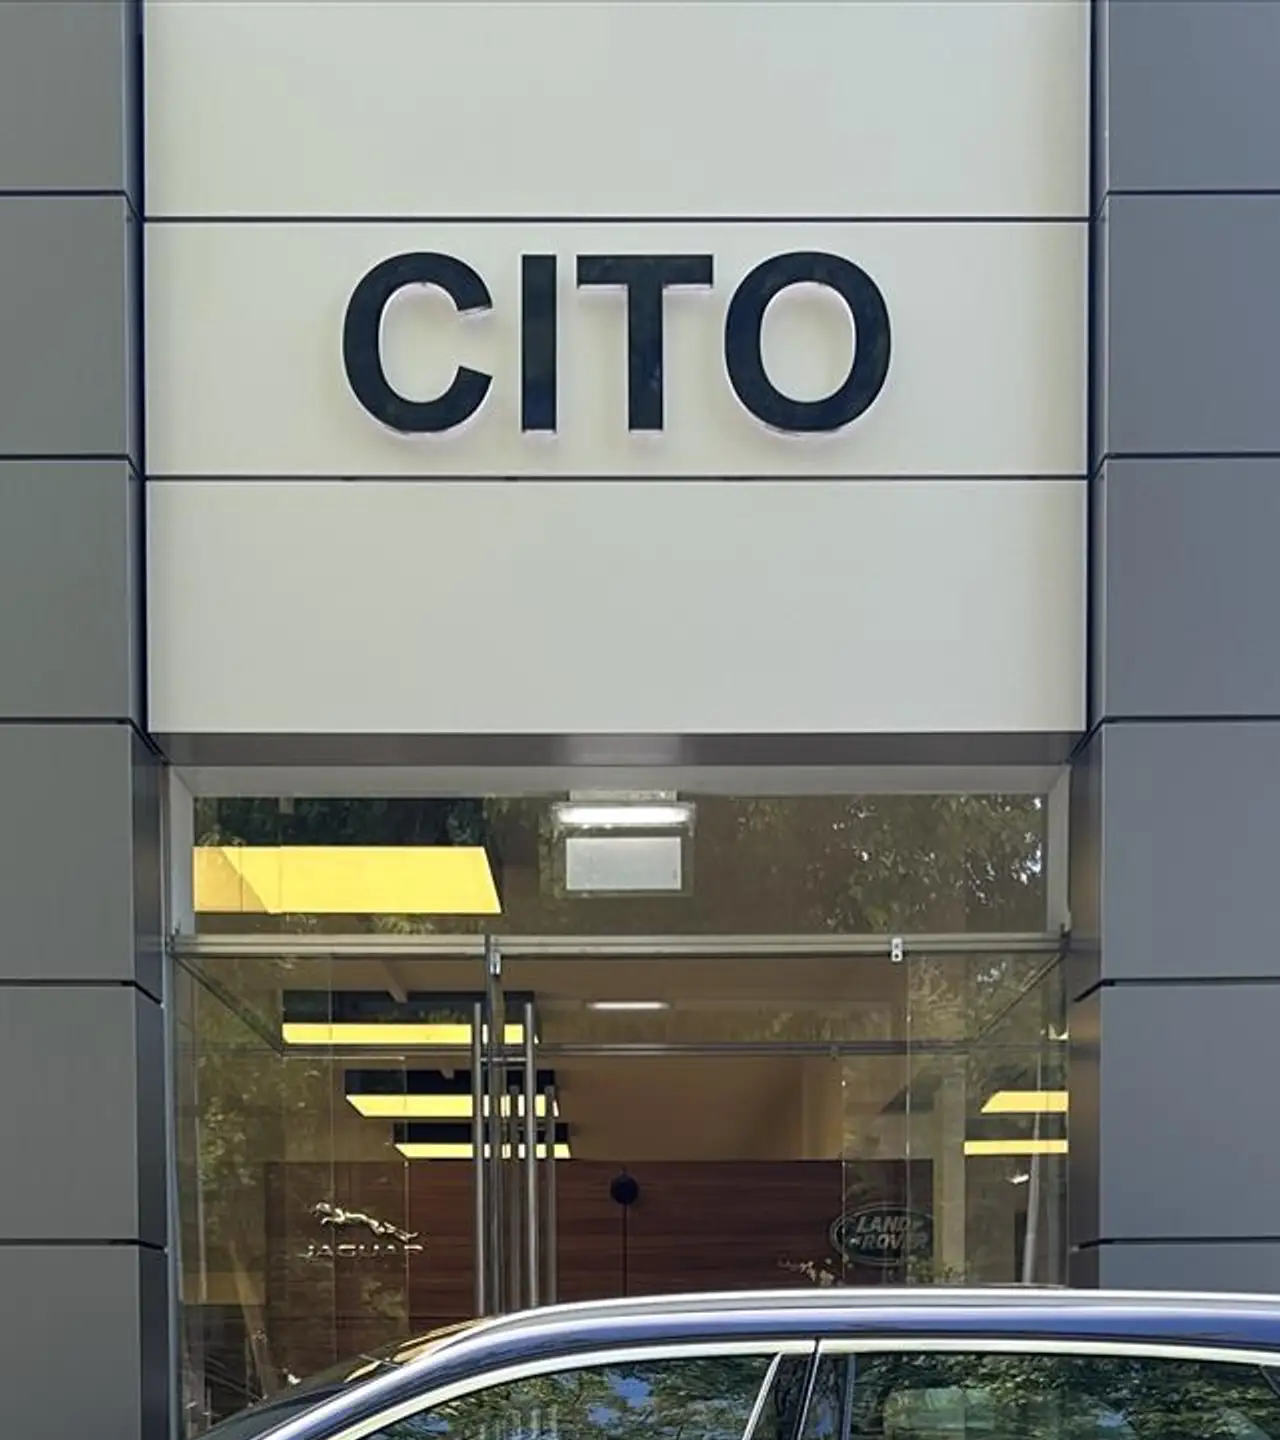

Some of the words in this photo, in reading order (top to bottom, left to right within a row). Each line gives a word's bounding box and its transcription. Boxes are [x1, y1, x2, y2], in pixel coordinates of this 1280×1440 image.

[342, 250, 892, 434] CITO
[855, 1215, 912, 1233] LAND
[859, 1232, 929, 1251] ROVER
[297, 1243, 424, 1259] JAGUAR
